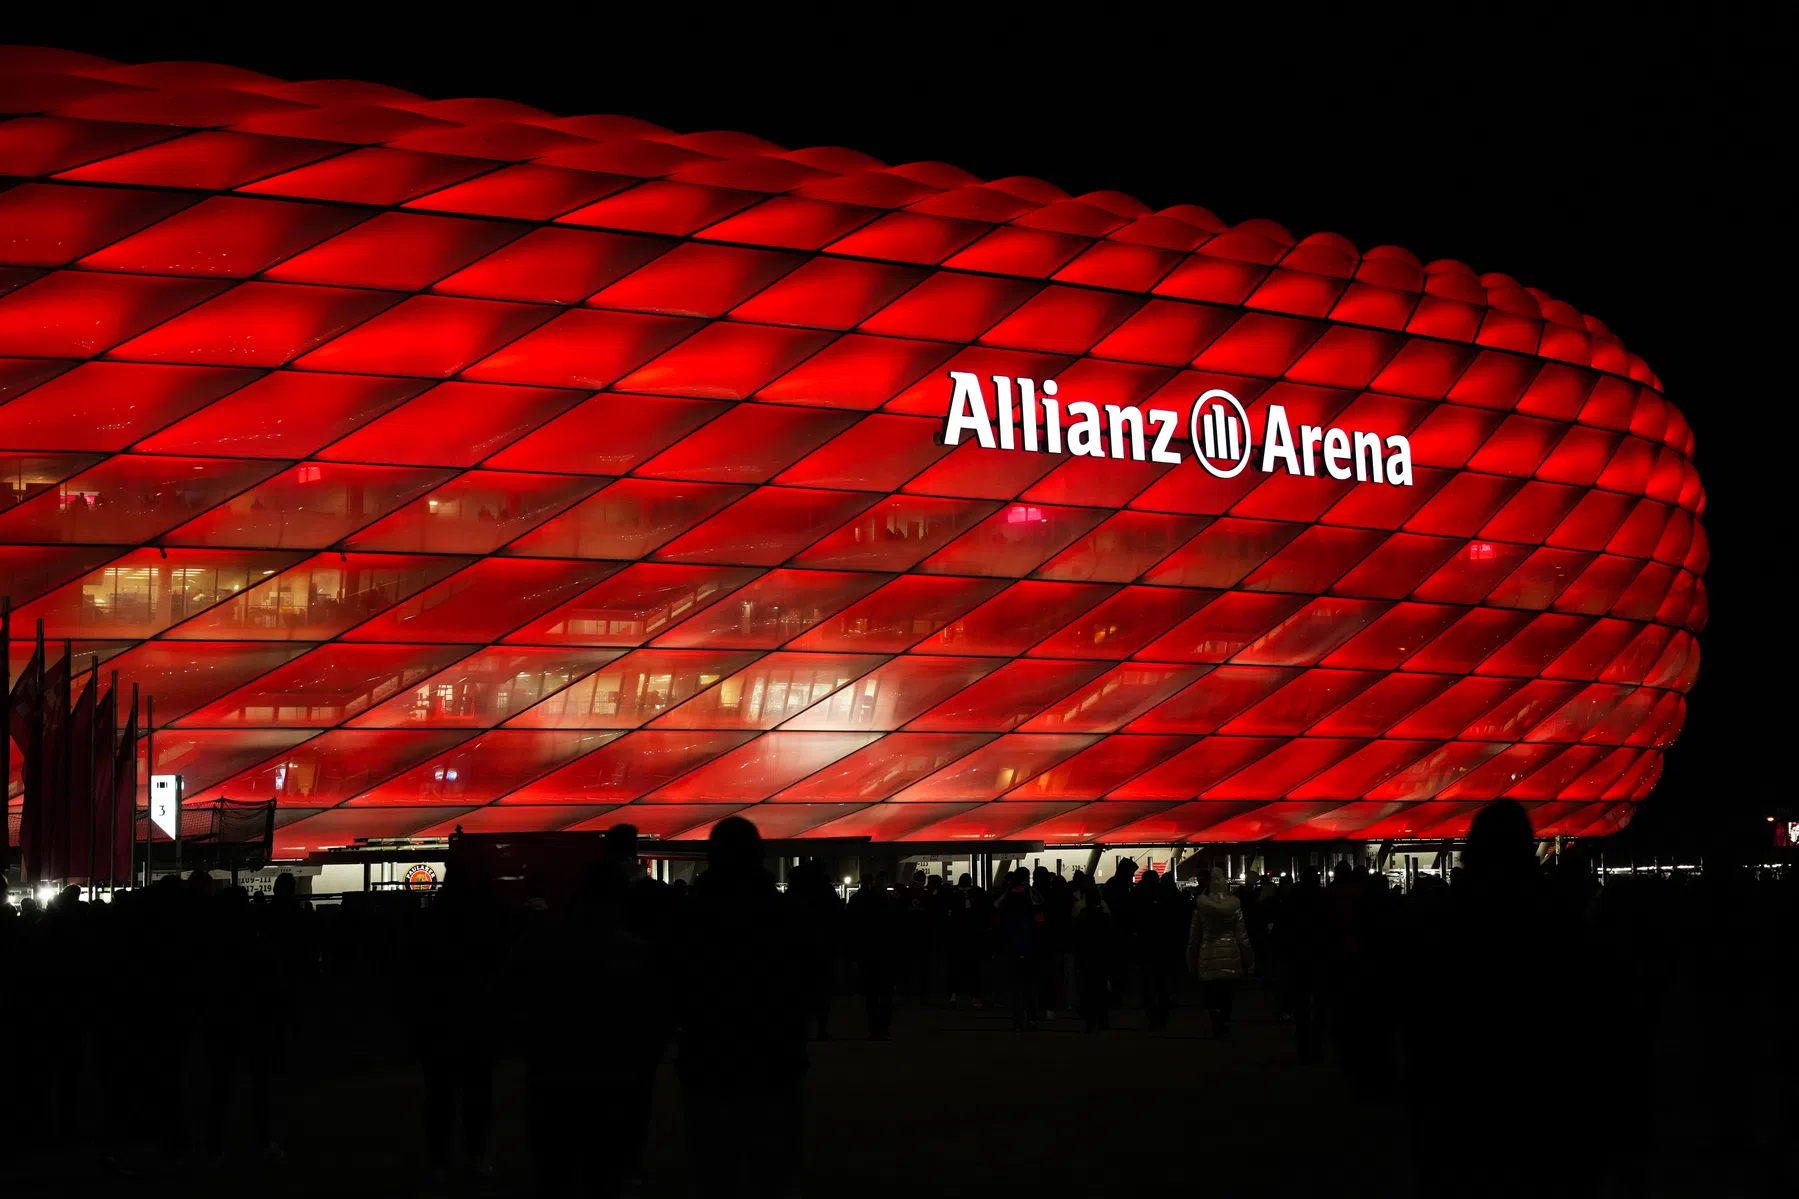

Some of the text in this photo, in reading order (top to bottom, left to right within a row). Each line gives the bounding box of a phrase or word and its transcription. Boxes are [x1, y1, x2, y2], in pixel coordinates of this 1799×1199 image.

[944, 371, 1413, 486] Allianz Arena
[158, 804, 166, 817] 3
[406, 865, 436, 879] PAULANER
